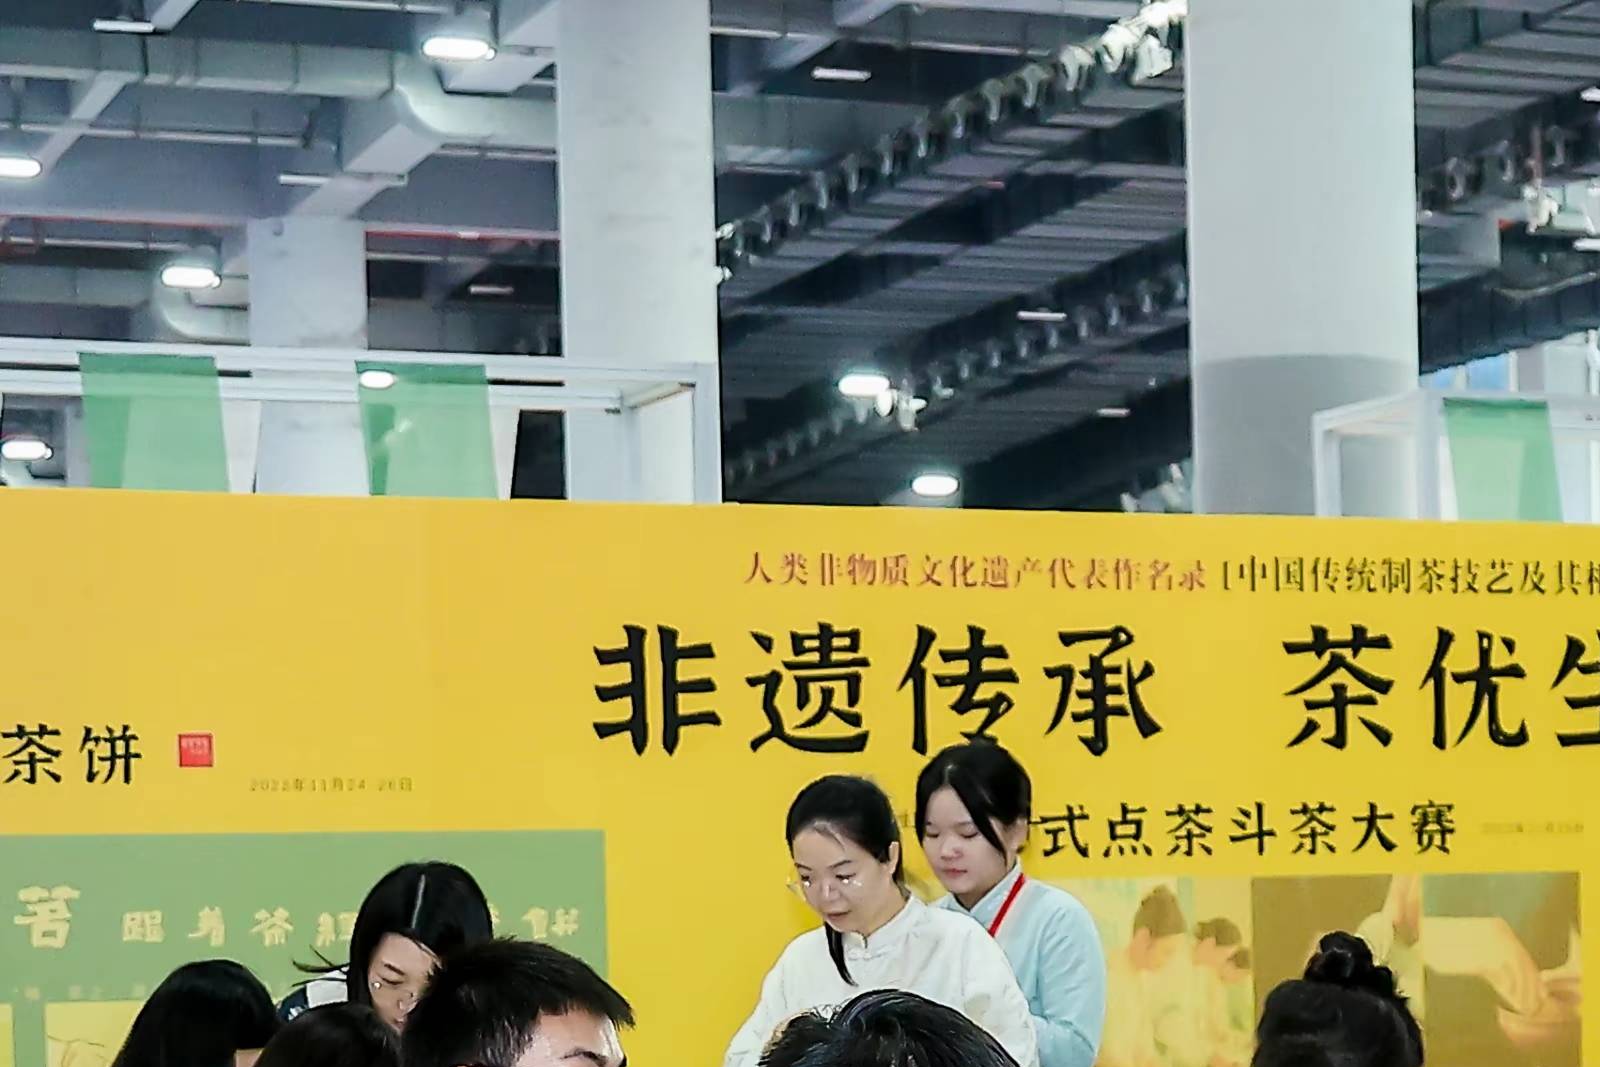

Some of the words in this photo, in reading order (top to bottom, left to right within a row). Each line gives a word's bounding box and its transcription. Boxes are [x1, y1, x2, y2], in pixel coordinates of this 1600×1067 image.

[592, 621, 1163, 757] 非遗传承
[1, 723, 142, 785] 茶饼
[1039, 800, 1457, 859] 式点茶斗茶大赛
